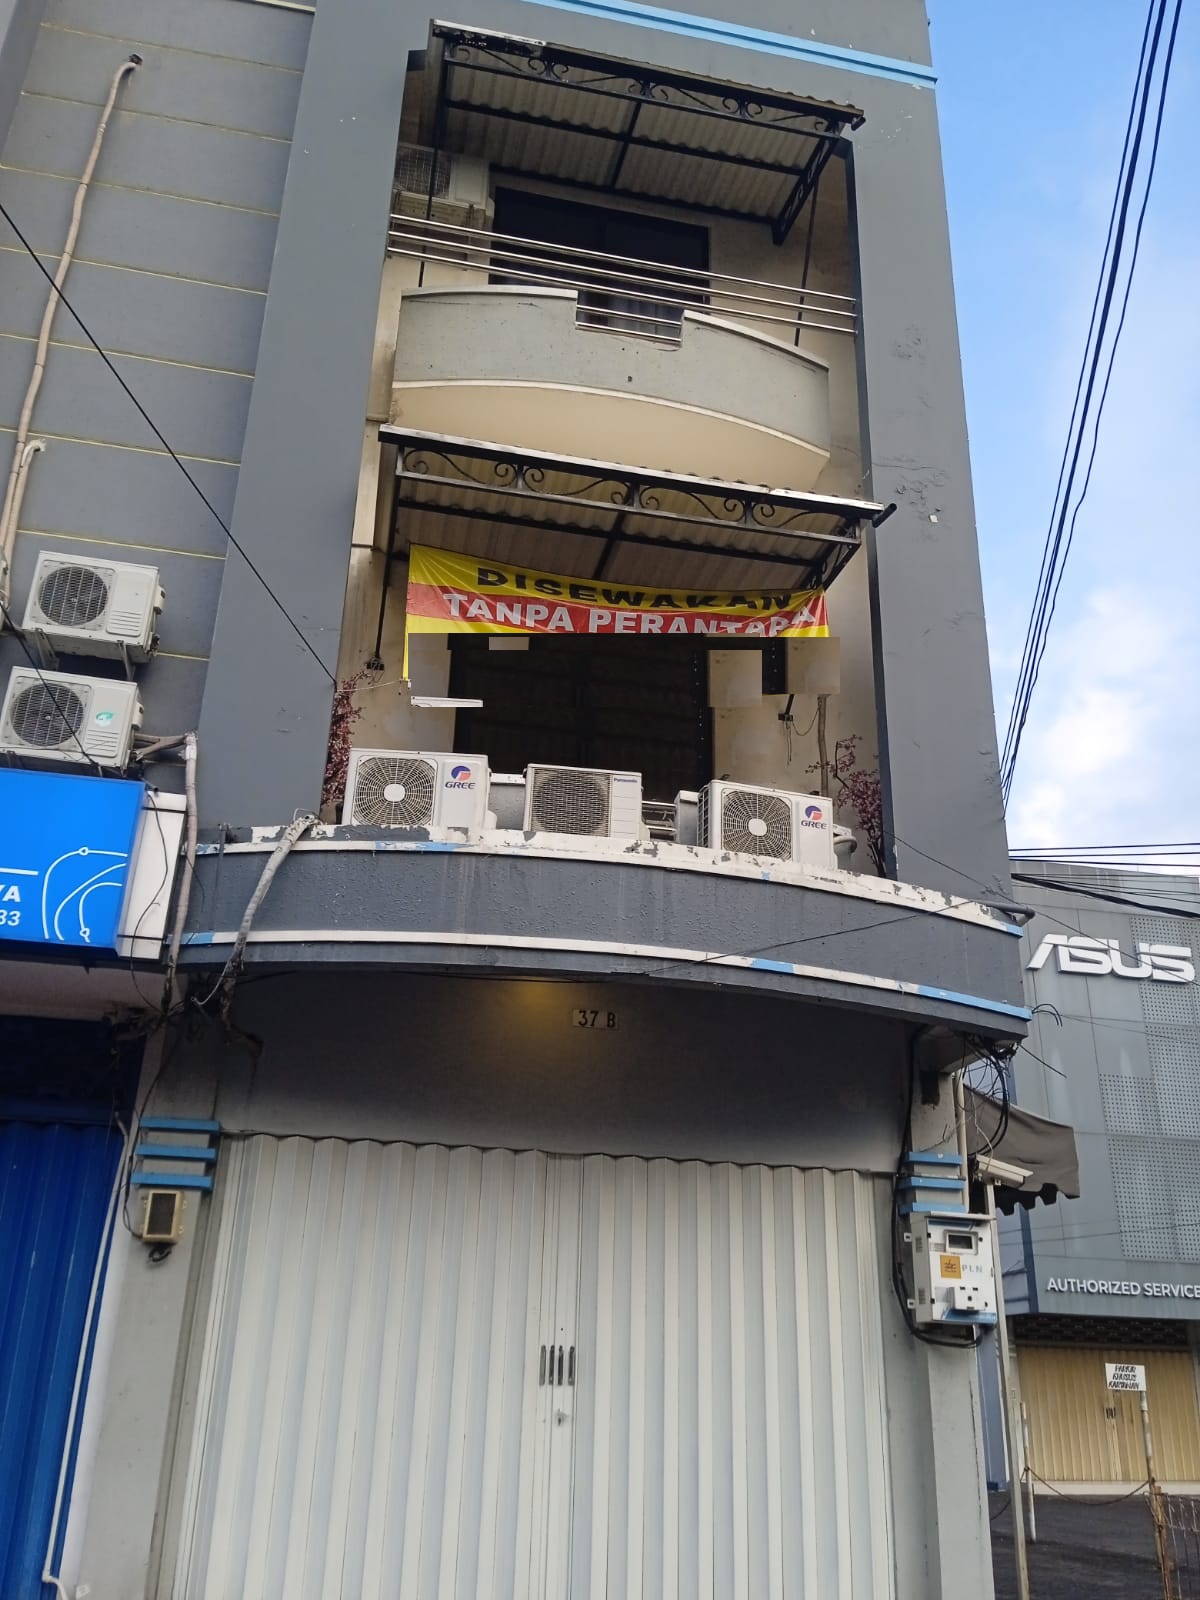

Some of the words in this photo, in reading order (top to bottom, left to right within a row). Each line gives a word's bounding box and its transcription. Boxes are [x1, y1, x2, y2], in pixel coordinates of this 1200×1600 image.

[478, 567, 792, 611] DISEWAKAN
[443, 593, 574, 632] TANPA
[445, 781, 476, 790] GREE
[801, 820, 827, 830] GREE
[1026, 933, 1196, 983] ASUS
[578, 1010, 599, 1027] 37
[1047, 1277, 1141, 1296] AUTHORIZED
[1143, 1282, 1200, 1298] SERVICE
